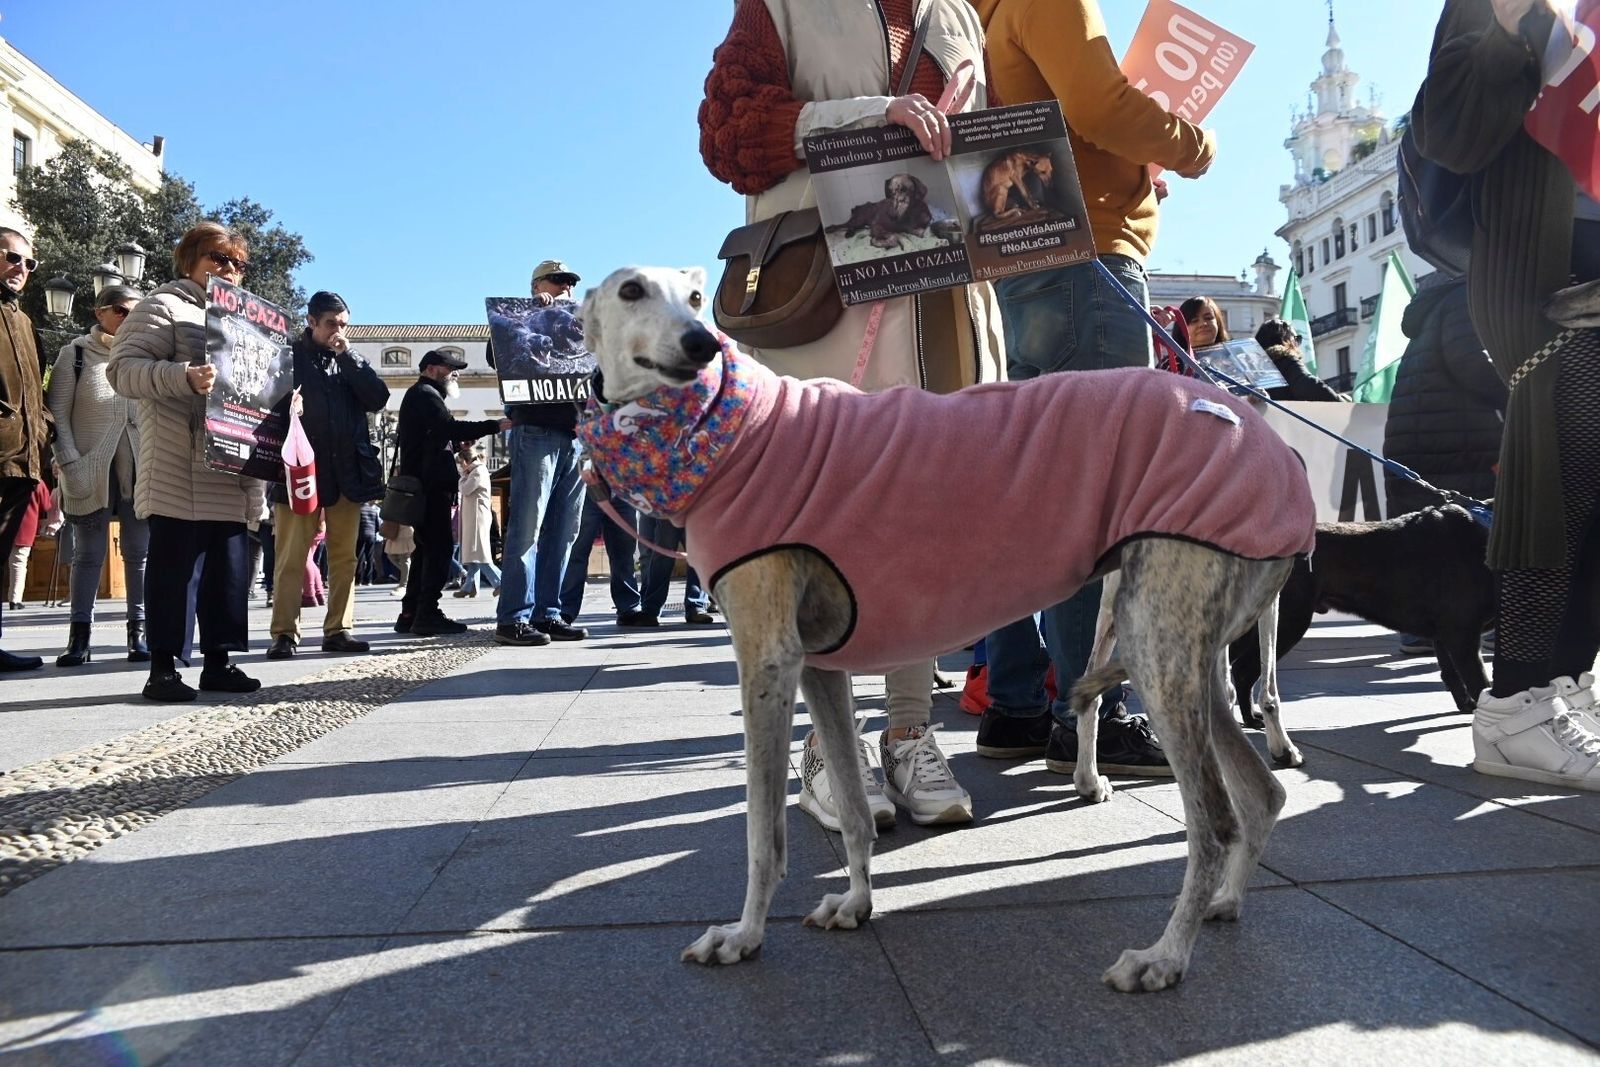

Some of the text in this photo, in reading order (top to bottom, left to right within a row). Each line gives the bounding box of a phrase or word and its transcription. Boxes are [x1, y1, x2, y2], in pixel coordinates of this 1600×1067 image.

[956, 119, 972, 127] Caza
[1017, 116, 1046, 126] desprecio
[964, 132, 992, 143] absoluto
[992, 131, 1003, 140] por
[1003, 129, 1009, 137] la
[1023, 124, 1044, 133] animal
[807, 135, 877, 153] Sufrimiento,
[820, 151, 874, 167] abandono
[876, 150, 883, 161] y
[979, 218, 1076, 244] #RespetoVidaAnimal
[1001, 236, 1061, 254] #NoALaCaza
[855, 265, 876, 281] NO
[881, 264, 893, 276] A
[893, 260, 913, 273] LA
[916, 249, 965, 269] CAZA!!!
[976, 250, 1091, 278] #MismosPerrosMismaLey
[842, 272, 969, 303] #MismosPerrosMismaLey
[213, 285, 238, 312] NO
[246, 300, 288, 335] CAZA
[269, 331, 287, 346] 2024
[531, 379, 554, 401] NO
[556, 379, 567, 400] A
